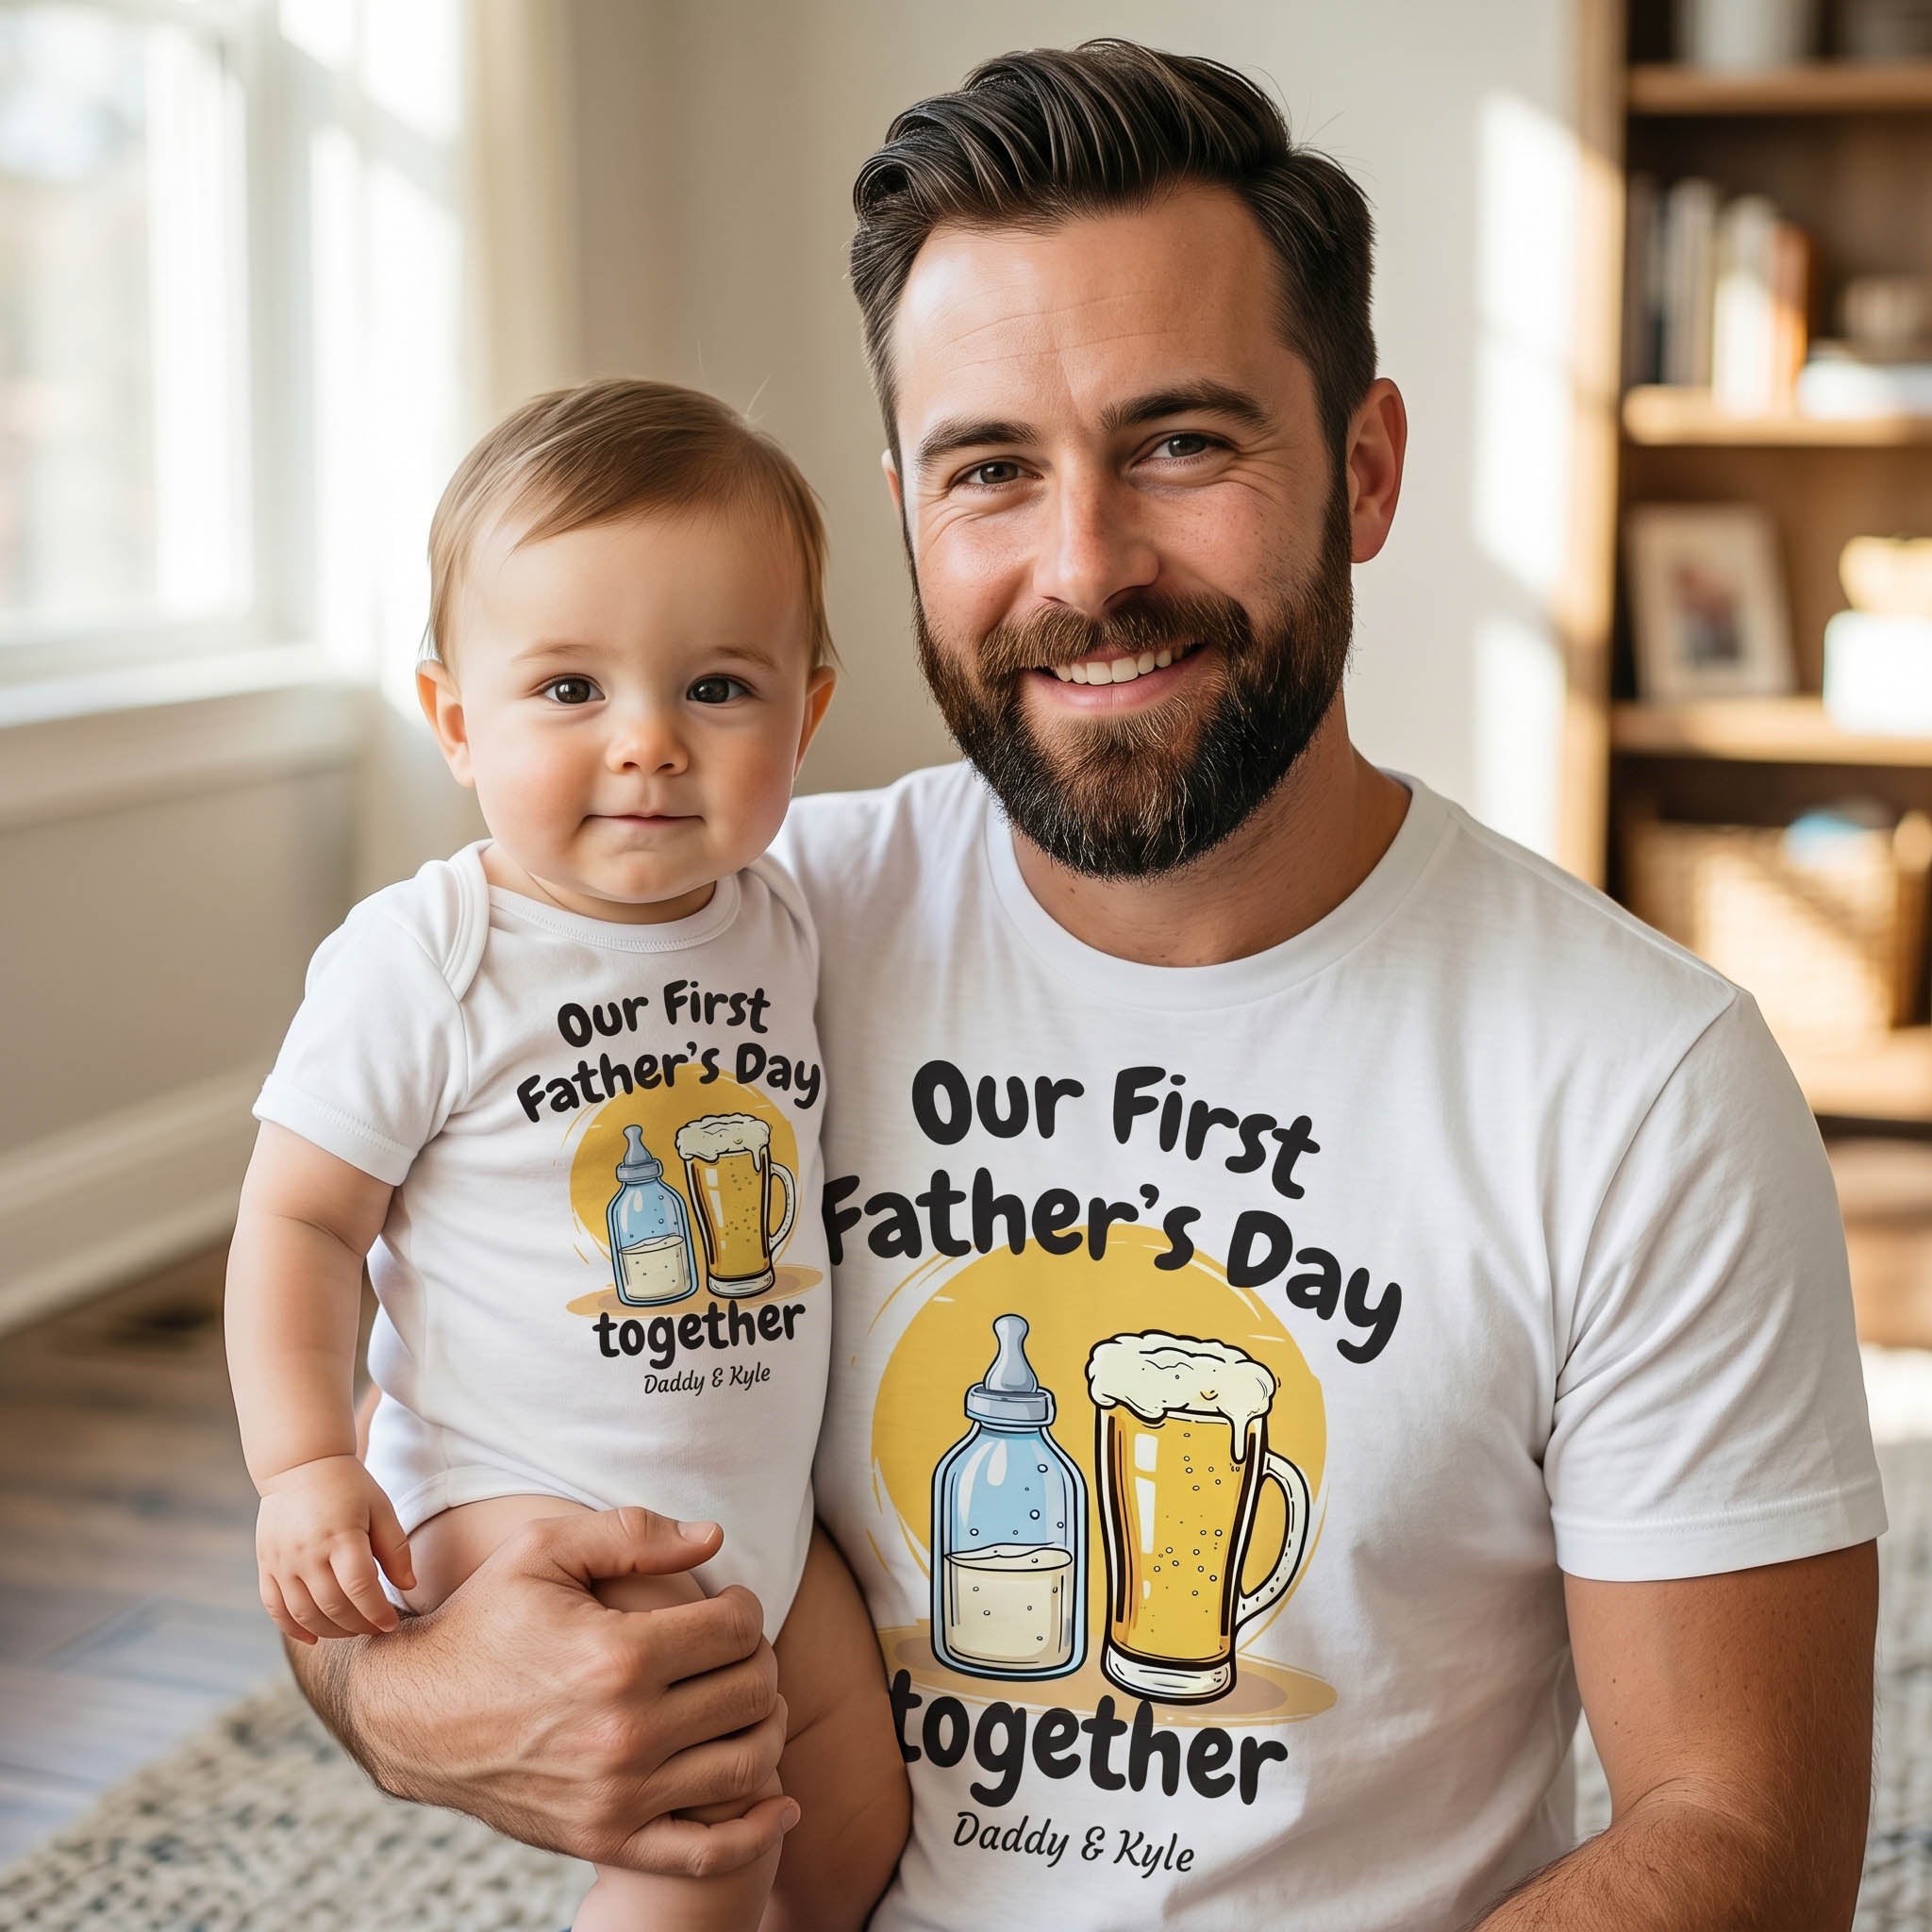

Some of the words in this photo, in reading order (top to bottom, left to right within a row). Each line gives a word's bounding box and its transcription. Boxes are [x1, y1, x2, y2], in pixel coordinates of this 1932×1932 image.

[558, 997, 648, 1047] Our
[664, 980, 771, 1033] First
[517, 1041, 720, 1123] Father's
[736, 1042, 821, 1109] Day
[912, 1060, 1084, 1144] Our
[1113, 1066, 1320, 1199] First
[822, 1167, 1200, 1270] Father's
[1226, 1210, 1401, 1364] Day
[592, 1300, 806, 1369] together
[644, 1371, 705, 1396] Daddy
[712, 1368, 723, 1388] &
[729, 1361, 770, 1387] Kyle
[890, 1669, 1288, 1807] together
[954, 1811, 1069, 1867] Daddy
[1081, 1826, 1105, 1860] &
[1113, 1830, 1193, 1878] Kyle
